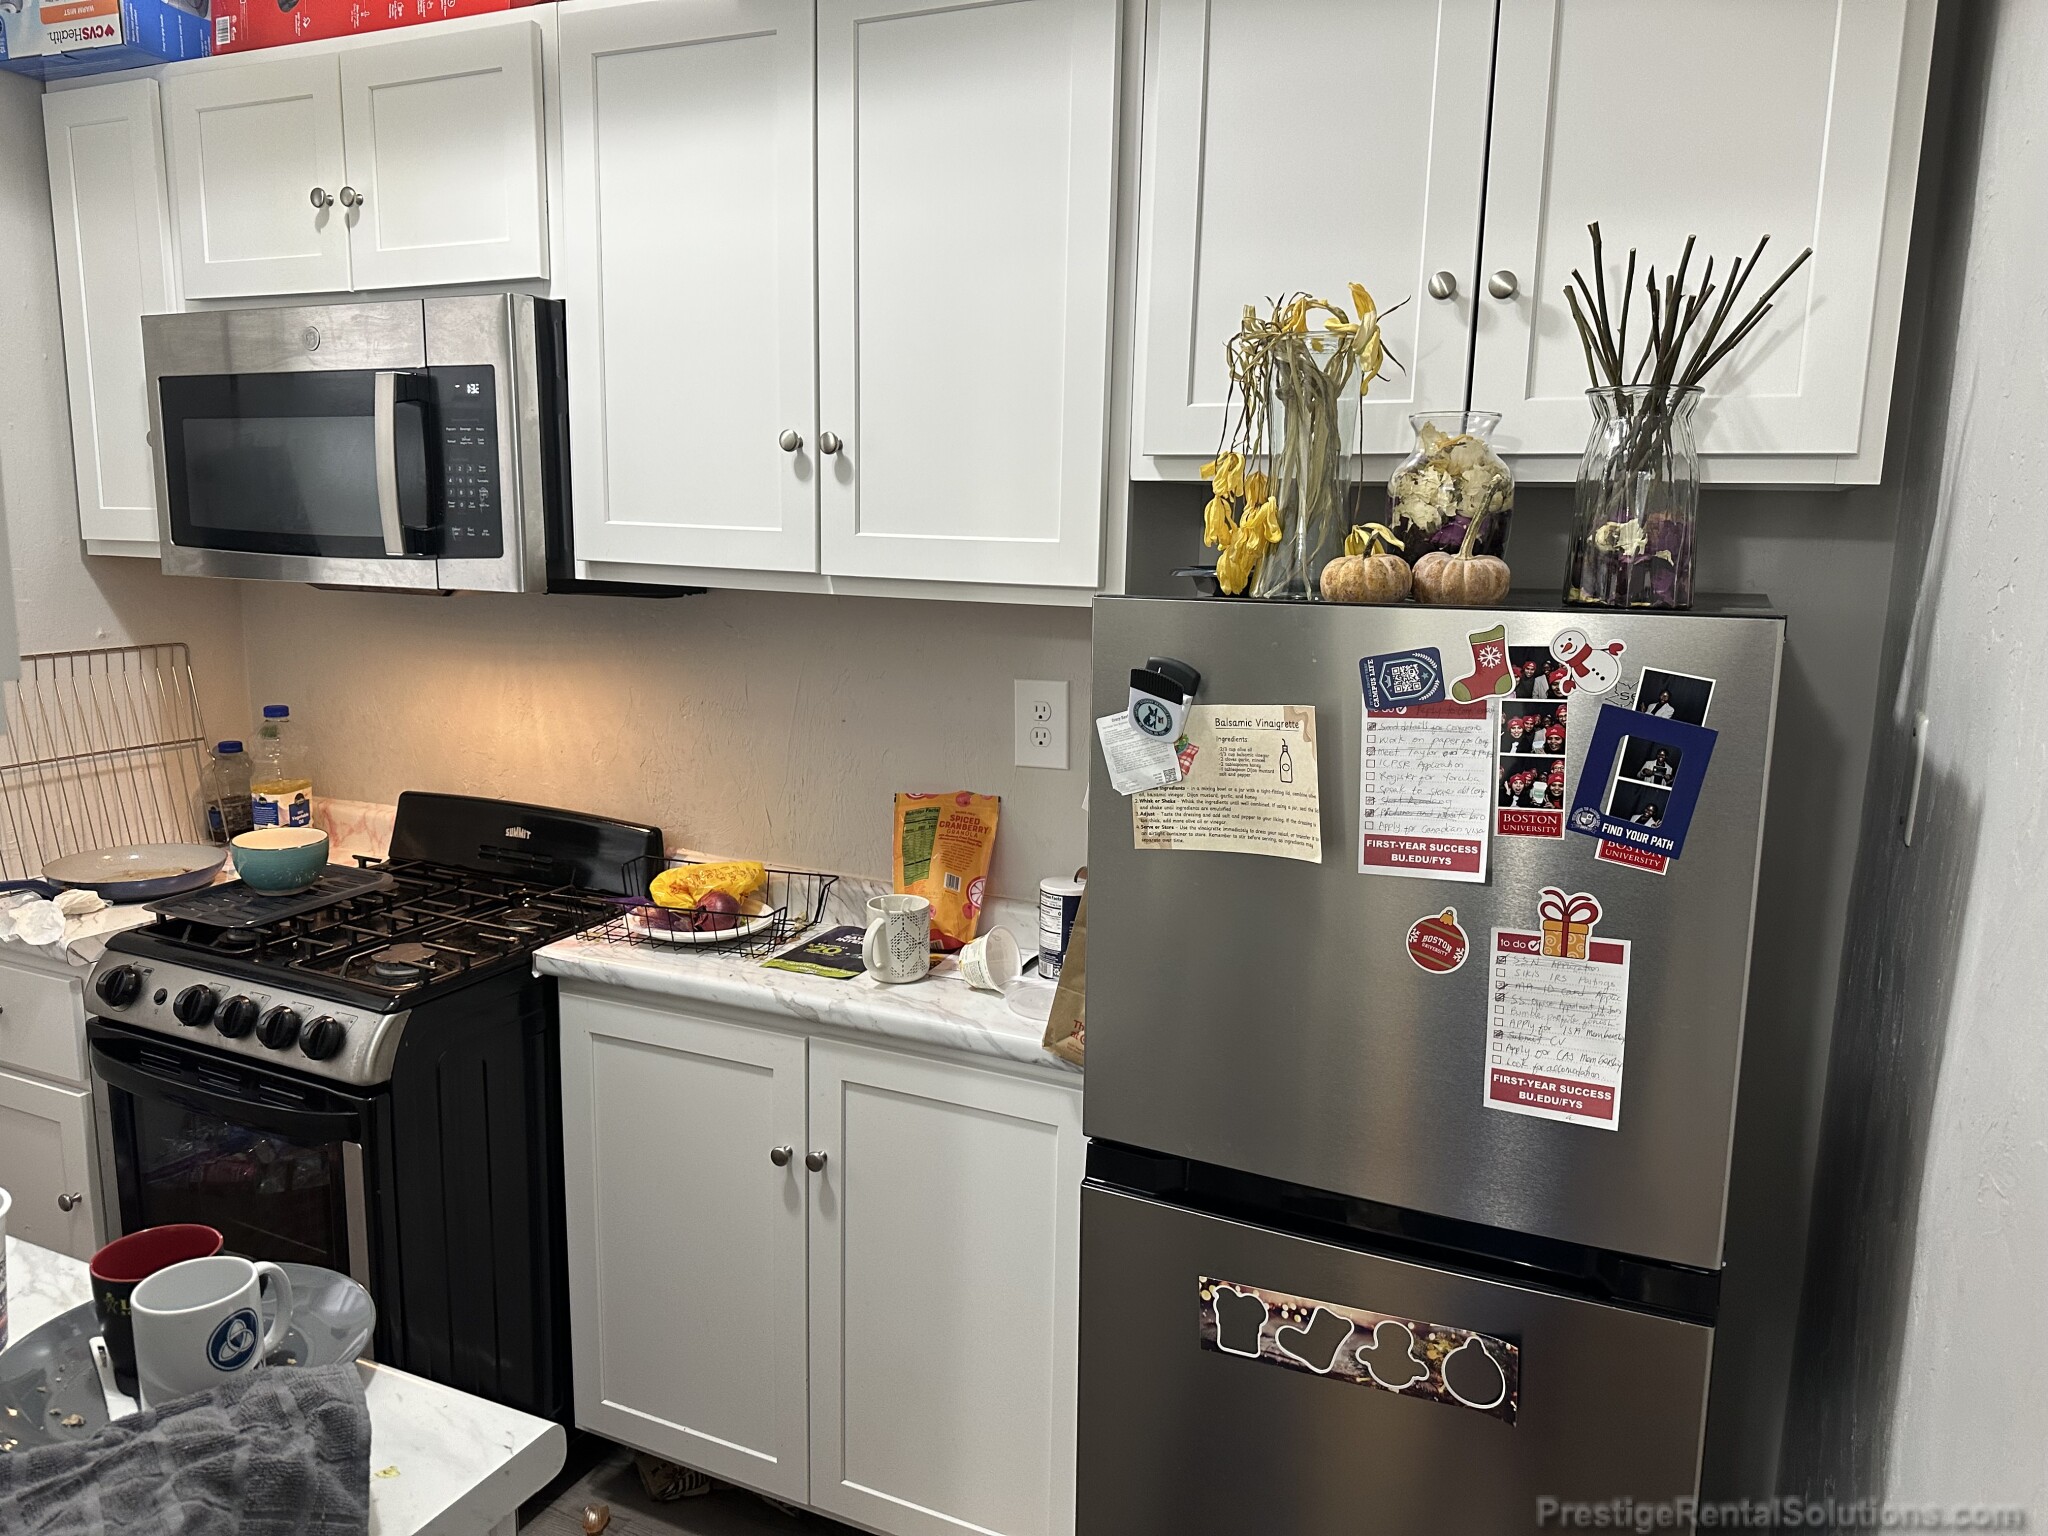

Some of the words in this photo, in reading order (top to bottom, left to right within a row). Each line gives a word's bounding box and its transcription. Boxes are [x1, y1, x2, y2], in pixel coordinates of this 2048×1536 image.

[1367, 658, 1376, 676] LIFE
[1370, 677, 1380, 708] CAMPUS
[1215, 718, 1252, 727] Balsamic
[1255, 719, 1299, 730] Vinaigrette
[950, 814, 980, 826] SPICED
[1504, 814, 1558, 824] BOSTON
[506, 826, 532, 840] SUMMIT
[939, 820, 989, 834] CRANBERRY
[946, 828, 978, 838] GRANOLA
[1379, 822, 1401, 833] Apply
[1502, 824, 1558, 833] UNIVERSITY
[1602, 822, 1624, 836] FIND
[1626, 828, 1650, 844] YOUR
[1650, 836, 1674, 850] PATH
[1366, 840, 1426, 852] FIRST-YEAR
[1429, 843, 1478, 854] SUCCESS
[1391, 854, 1452, 866] BU.EDU/FYS
[1605, 848, 1661, 867] UNIVERSITY
[1421, 935, 1452, 954] BOSTON
[1421, 942, 1448, 956] UNIVERSITY
[1513, 940, 1526, 948] do
[1550, 1036, 1566, 1046] CV
[1506, 1044, 1530, 1059] Apply
[1494, 1074, 1556, 1092] FIRST-YEAR
[1560, 1084, 1612, 1100] SUCCESS
[1518, 1090, 1584, 1109] BU.EDU/FYS
